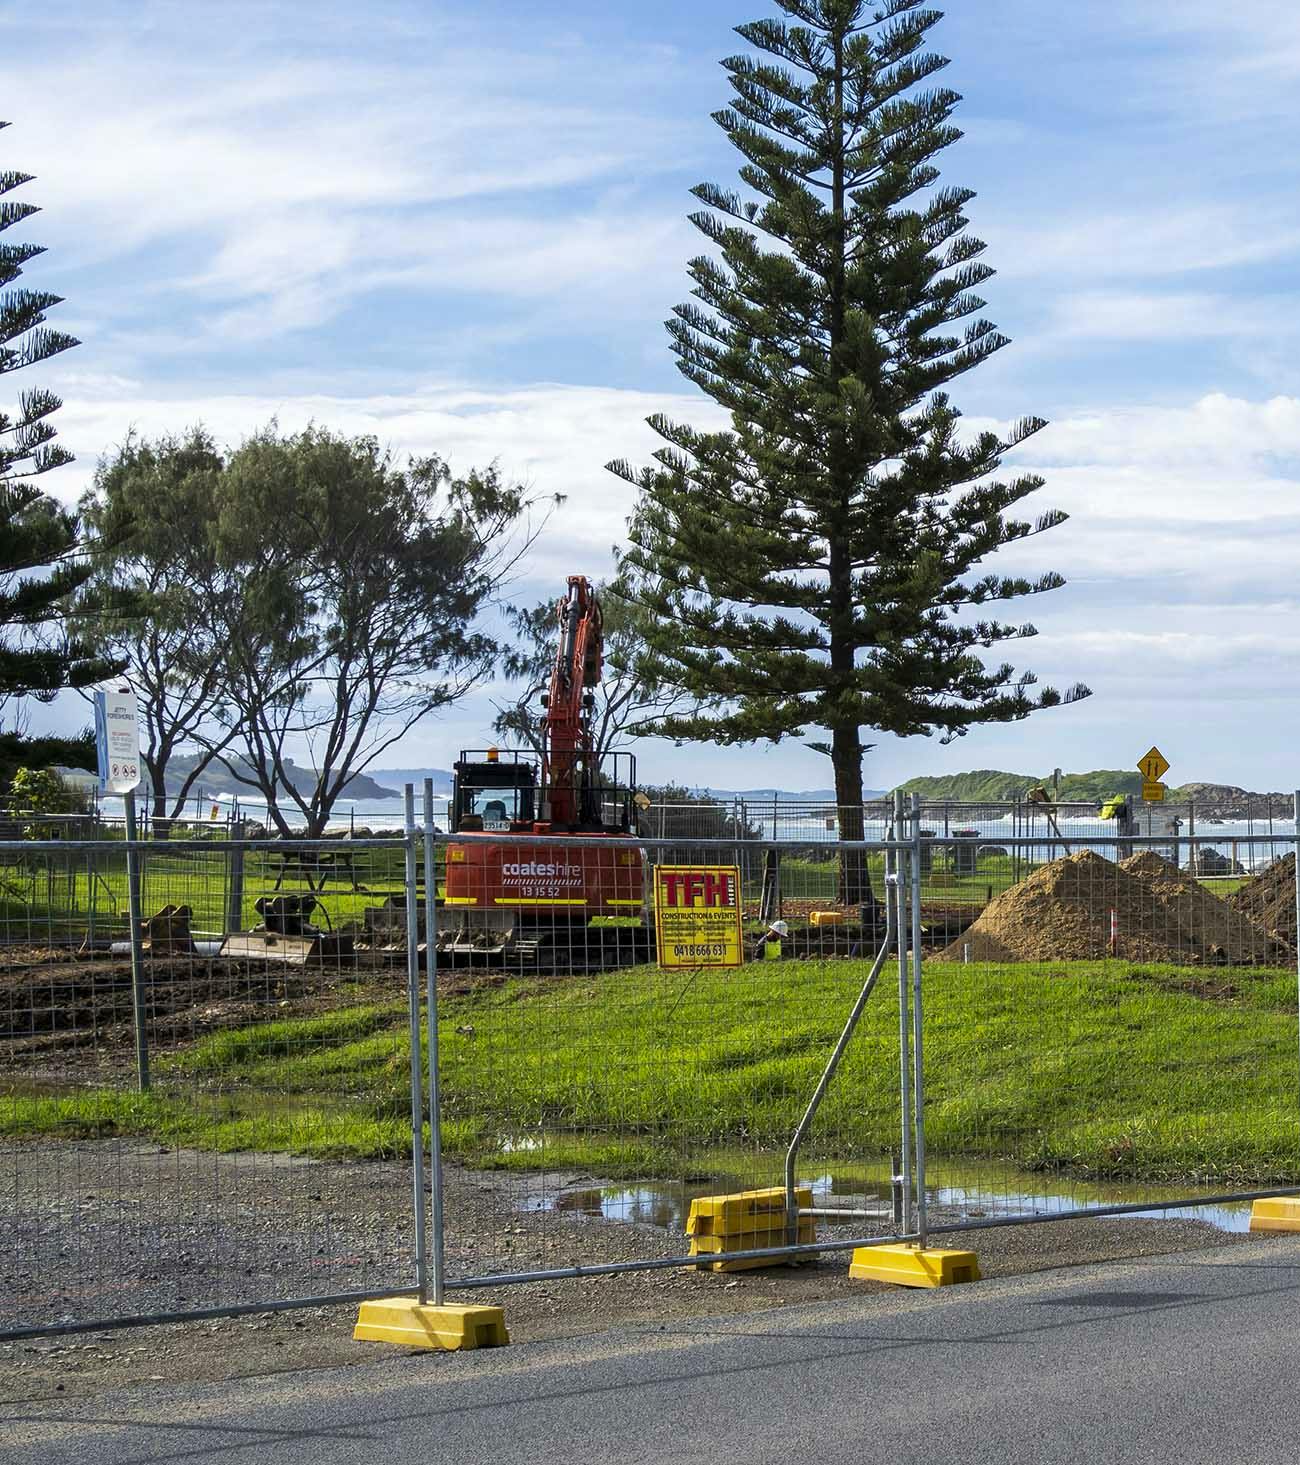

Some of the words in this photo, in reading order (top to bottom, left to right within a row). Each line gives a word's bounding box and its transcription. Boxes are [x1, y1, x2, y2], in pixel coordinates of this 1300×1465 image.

[522, 887, 532, 896] 13
[536, 887, 545, 896] 15
[548, 887, 560, 896] 52
[660, 873, 729, 907] TFH
[661, 912, 707, 920] CONSTRUCTION
[674, 945, 694, 956] 0418
